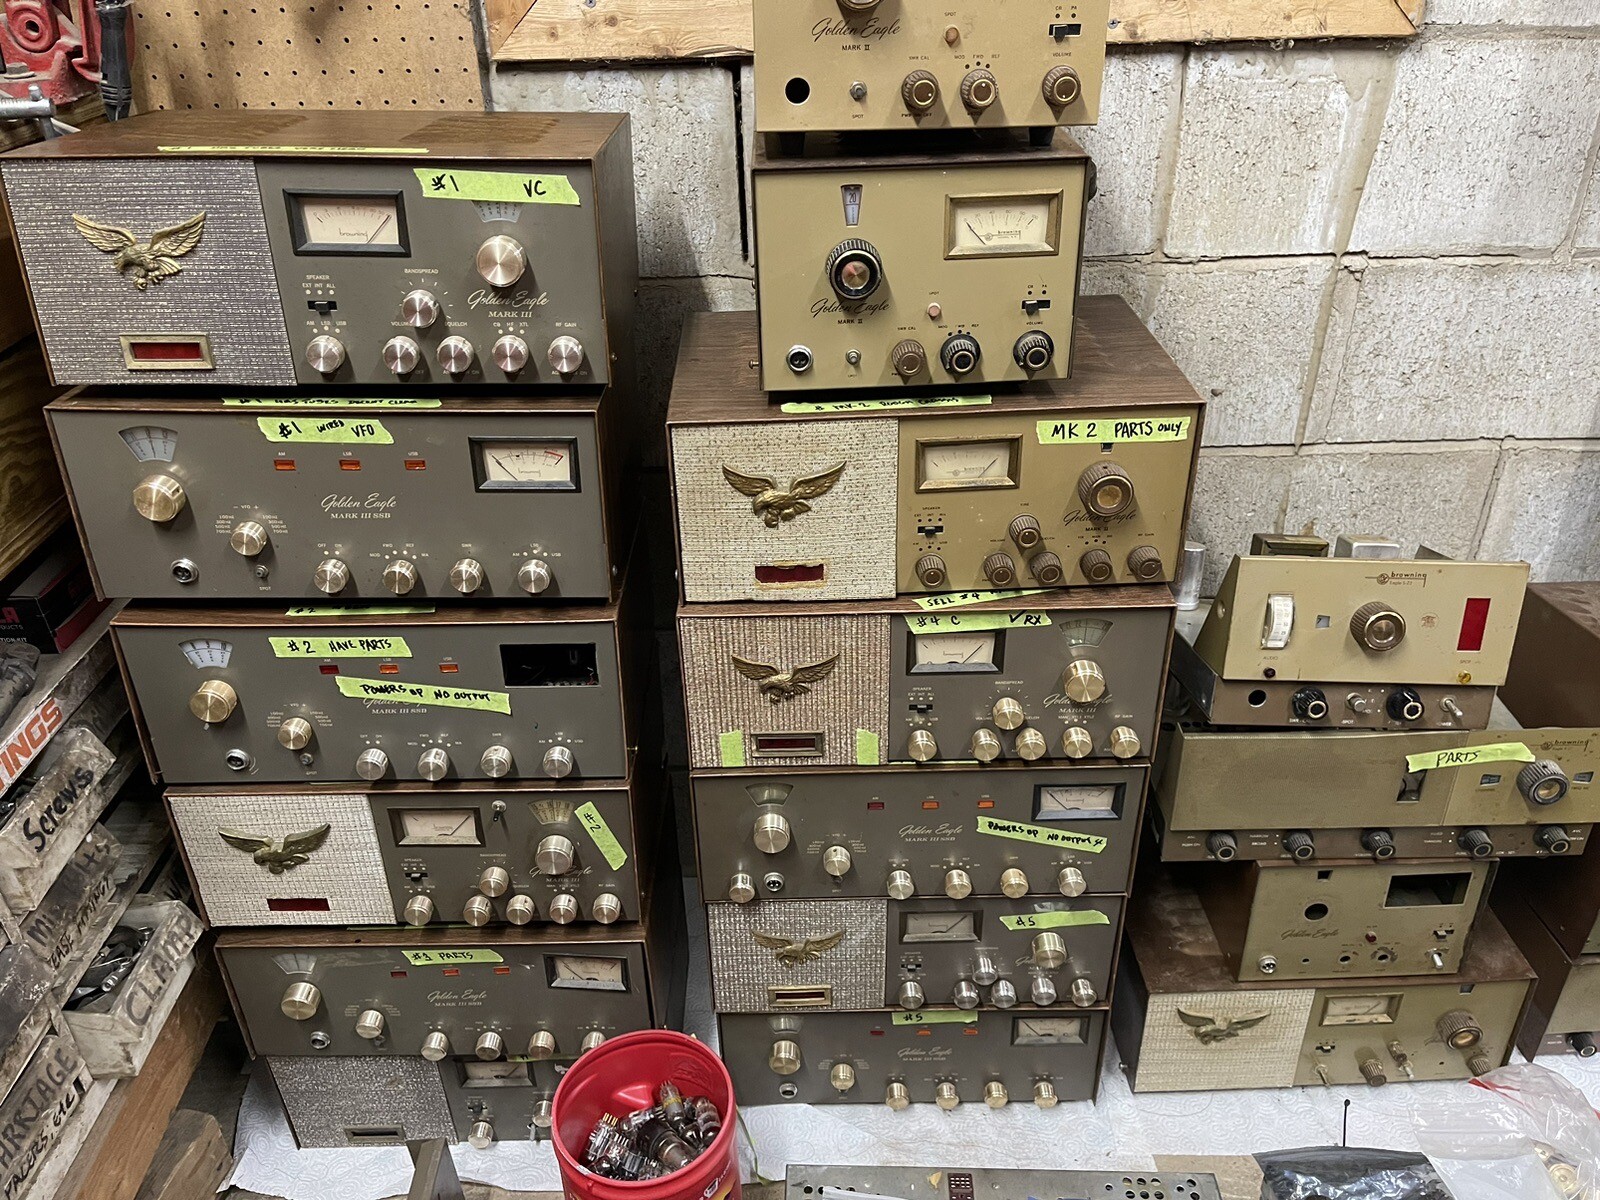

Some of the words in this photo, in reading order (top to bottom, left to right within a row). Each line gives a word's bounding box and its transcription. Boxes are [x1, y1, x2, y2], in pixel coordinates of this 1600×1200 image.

[812, 18, 859, 42] Golden
[860, 17, 901, 40] Eagle
[523, 180, 547, 198] VC
[849, 192, 857, 204] 20
[467, 289, 511, 310] Golden
[512, 290, 550, 310] Eagle
[810, 298, 852, 318] Golden
[854, 299, 890, 316] Eagle
[278, 420, 302, 438] #1
[316, 420, 345, 432] WIRED
[351, 424, 375, 438] VFO
[1052, 422, 1079, 440] MK
[1086, 422, 1098, 438] 2
[1114, 420, 1153, 438] PARTS
[1158, 422, 1183, 436] ONLY
[320, 494, 361, 512] Golden
[364, 492, 397, 512] Eagle
[926, 597, 956, 607] SELL
[916, 615, 940, 628] #4
[287, 639, 316, 654] #2
[328, 640, 358, 652] HAVE
[358, 638, 393, 652] PARTS
[359, 684, 408, 696] POWERS
[434, 690, 450, 700] NO
[454, 692, 492, 702] OUTPUT
[1553, 740, 1590, 752] browning
[1436, 750, 1481, 768] PARTS
[23, 766, 94, 852] Screws
[583, 812, 602, 833] #2
[898, 824, 934, 838] Golden
[934, 822, 964, 838] Eagle
[988, 820, 1025, 834] POWERS
[1047, 834, 1060, 842] NO
[1060, 836, 1092, 846] OUTPUT
[1281, 930, 1312, 941] Golden
[1312, 928, 1339, 940] Eagle
[52, 930, 76, 970] EASE
[438, 952, 474, 960] PARTS
[427, 990, 458, 1003] Golden
[461, 989, 487, 1002] Eagle
[903, 1012, 923, 1022] #5
